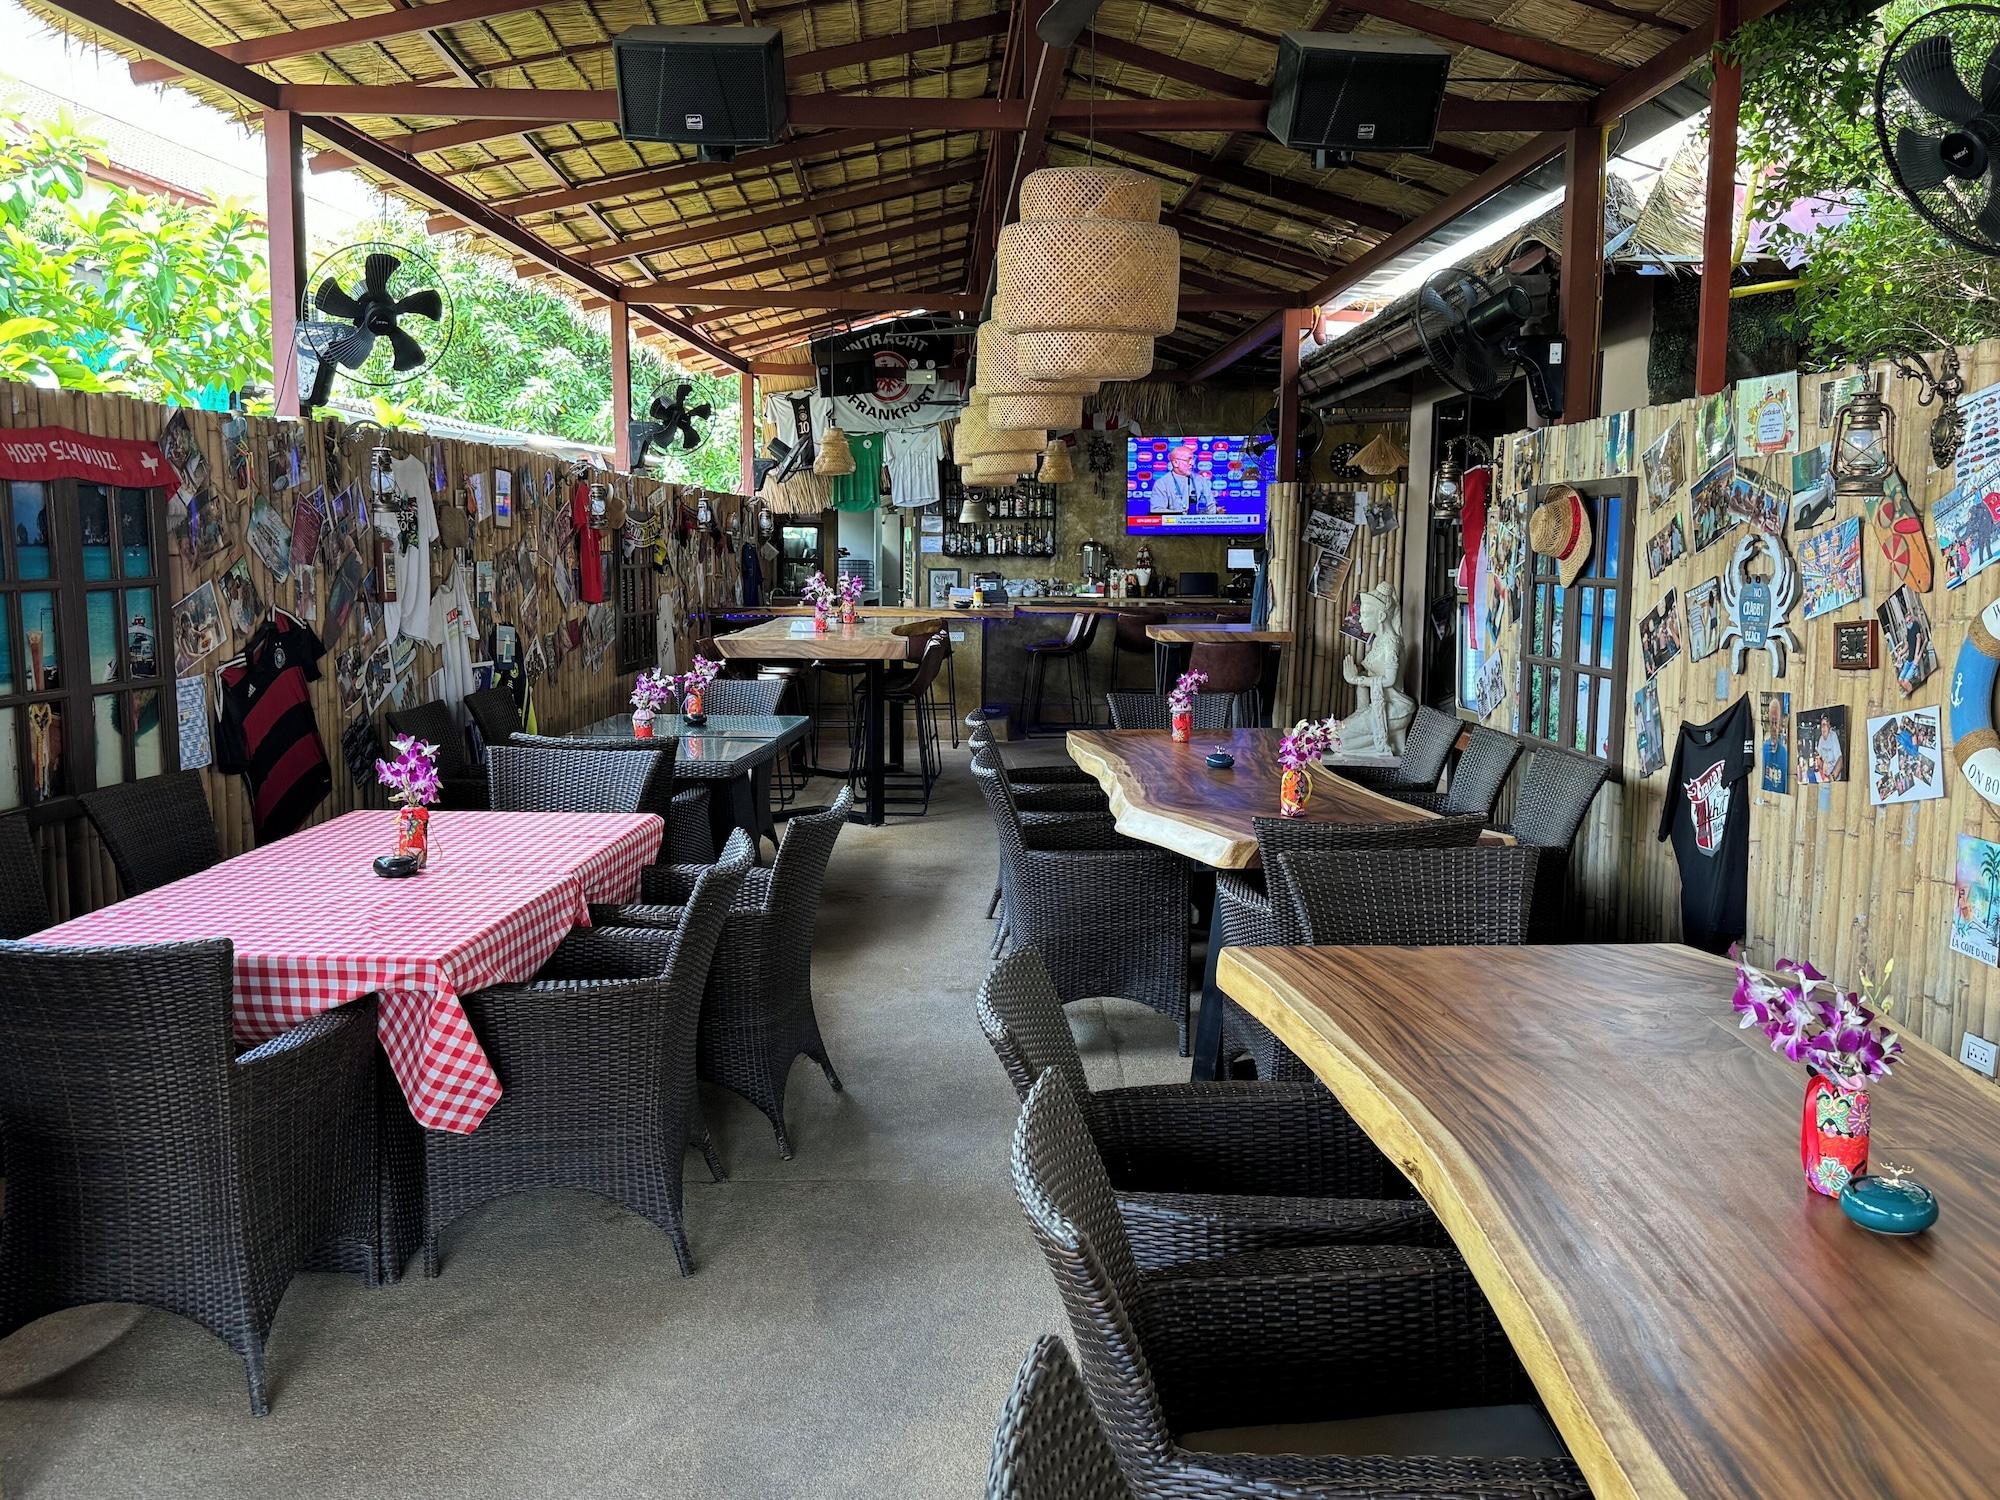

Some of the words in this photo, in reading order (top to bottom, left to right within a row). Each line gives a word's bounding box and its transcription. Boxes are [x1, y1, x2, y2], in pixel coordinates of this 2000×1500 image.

[798, 421, 810, 434] 10
[1, 442, 48, 463] HOPP
[1753, 587, 1763, 598] NO
[1968, 763, 1984, 785] ON
[1951, 938, 1959, 948] LA
